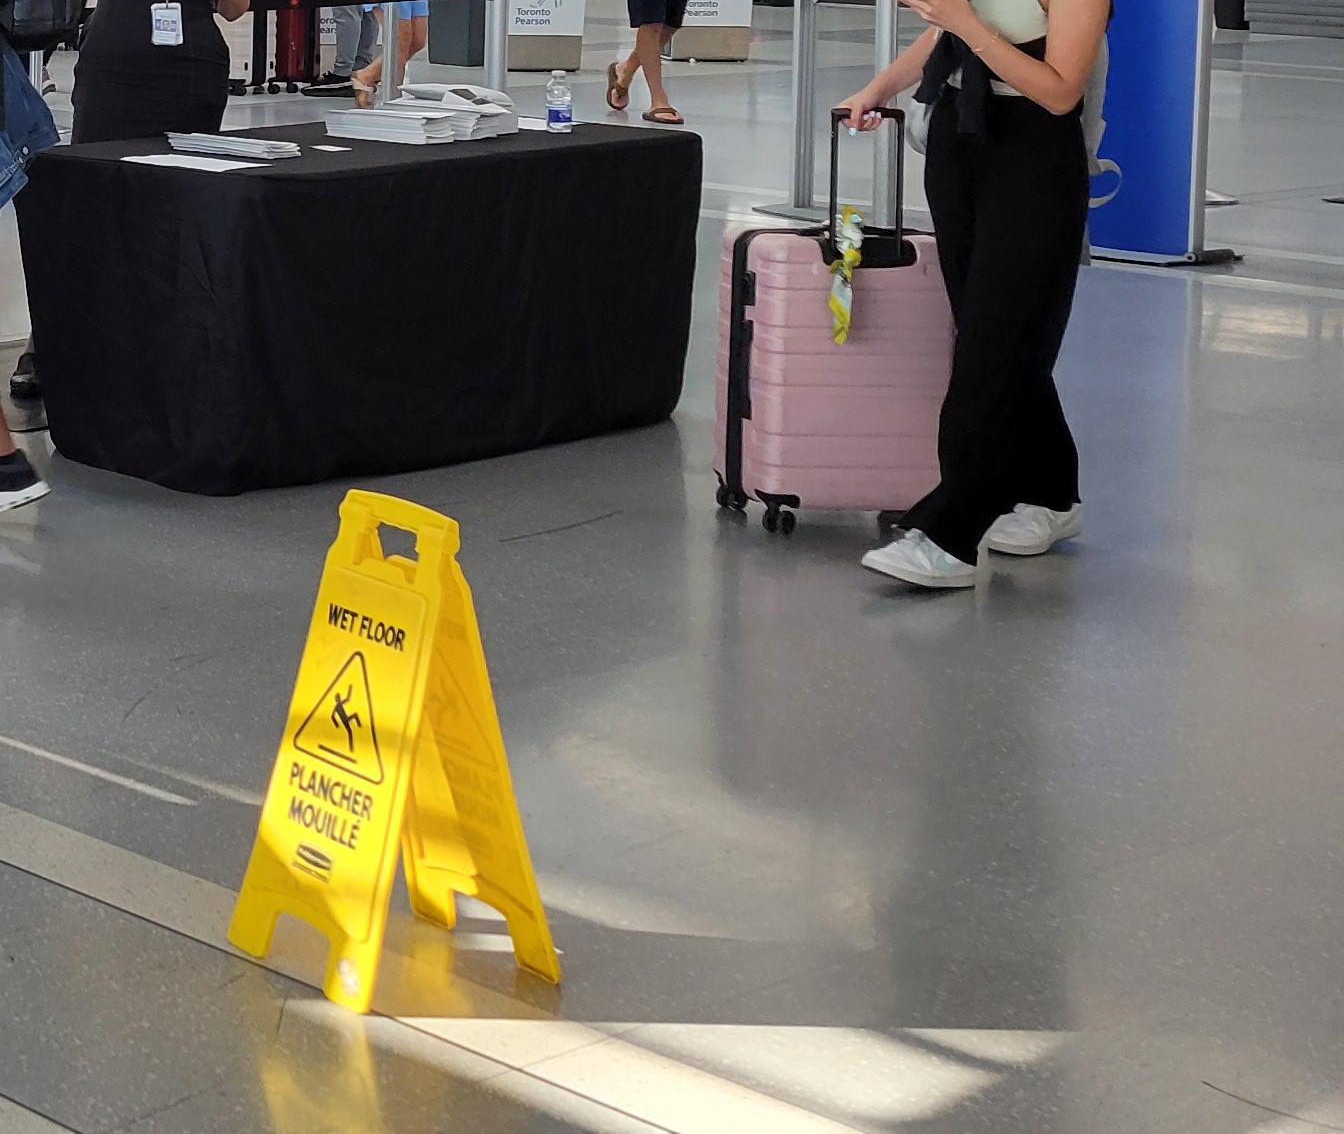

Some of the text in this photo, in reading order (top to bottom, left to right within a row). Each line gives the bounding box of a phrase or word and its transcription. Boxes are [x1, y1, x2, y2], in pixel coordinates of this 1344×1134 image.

[516, 17, 551, 25] Pearson
[517, 8, 551, 17] Toronto
[328, 603, 406, 652] WET FLOOR
[289, 762, 374, 821] PLANCHER
[288, 796, 360, 851] MOUILLÉ
